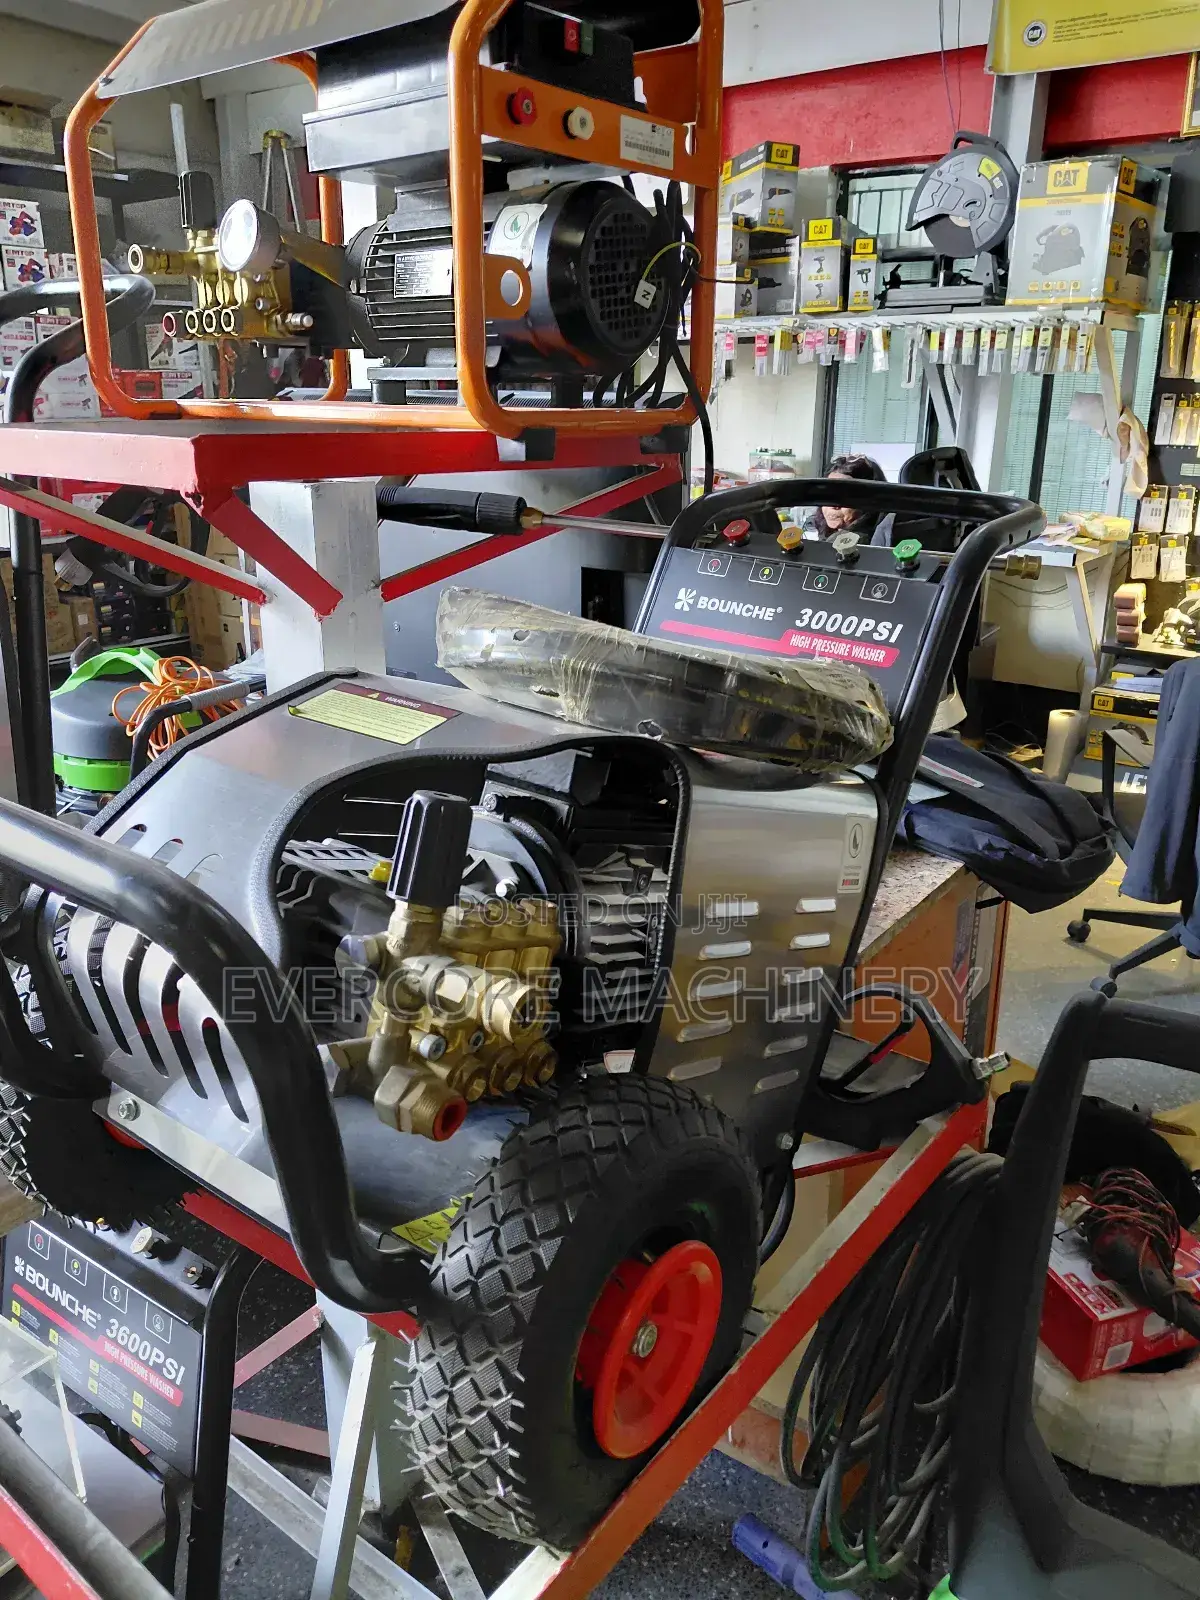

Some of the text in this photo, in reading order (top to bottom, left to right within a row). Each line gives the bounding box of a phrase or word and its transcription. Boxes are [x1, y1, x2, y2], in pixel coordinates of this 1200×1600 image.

[775, 148, 789, 159] CAT
[1053, 169, 1080, 188] CAT
[813, 224, 828, 235] CAT
[858, 242, 870, 250] CAT
[40, 317, 70, 325] EMTOP
[795, 608, 904, 643] 3000PSI
[790, 634, 887, 663] HIGH PRESSURE WASHER
[384, 696, 422, 709] WARNING
[1097, 698, 1110, 708] CAT
[1119, 772, 1148, 795] LE
[105, 1318, 186, 1386] 3600PSI
[103, 1340, 120, 1360] HIGH
[118, 1350, 148, 1381] PRESSURE
[149, 1370, 175, 1400] WASHER
